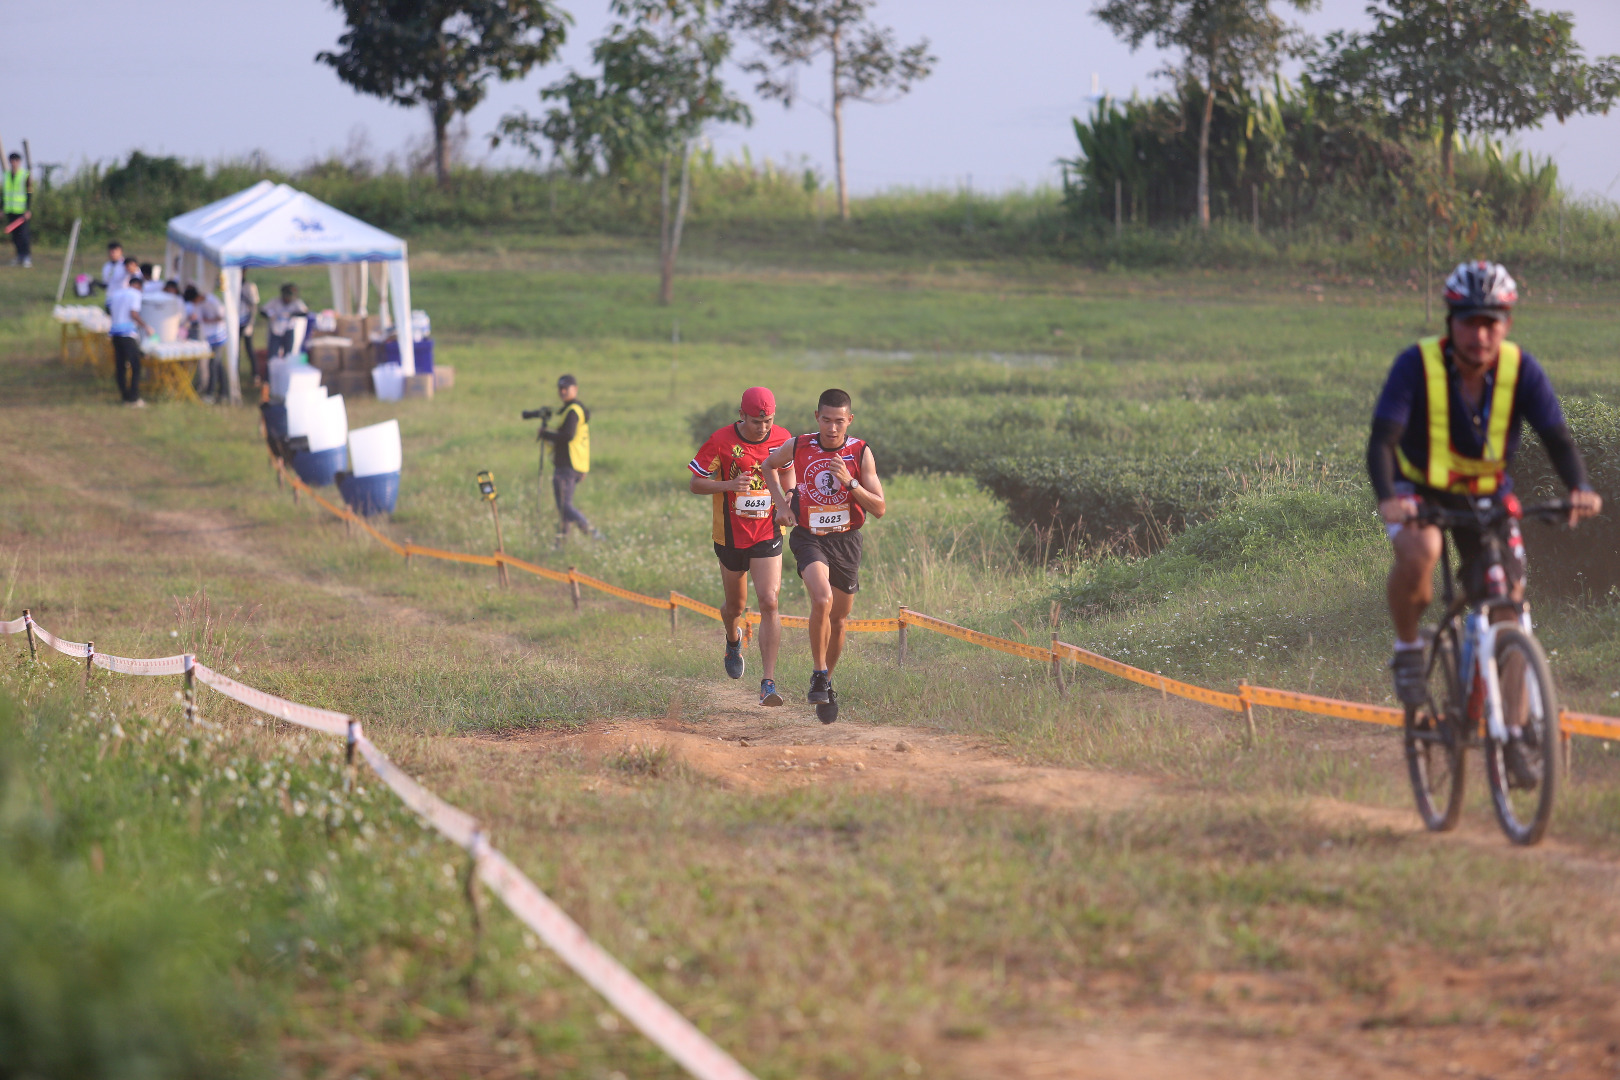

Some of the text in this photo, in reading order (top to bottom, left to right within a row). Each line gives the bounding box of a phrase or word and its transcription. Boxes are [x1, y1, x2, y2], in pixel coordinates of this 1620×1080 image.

[808, 462, 829, 477] SIANG
[744, 499, 766, 507] 8634
[819, 514, 842, 524] 8623
